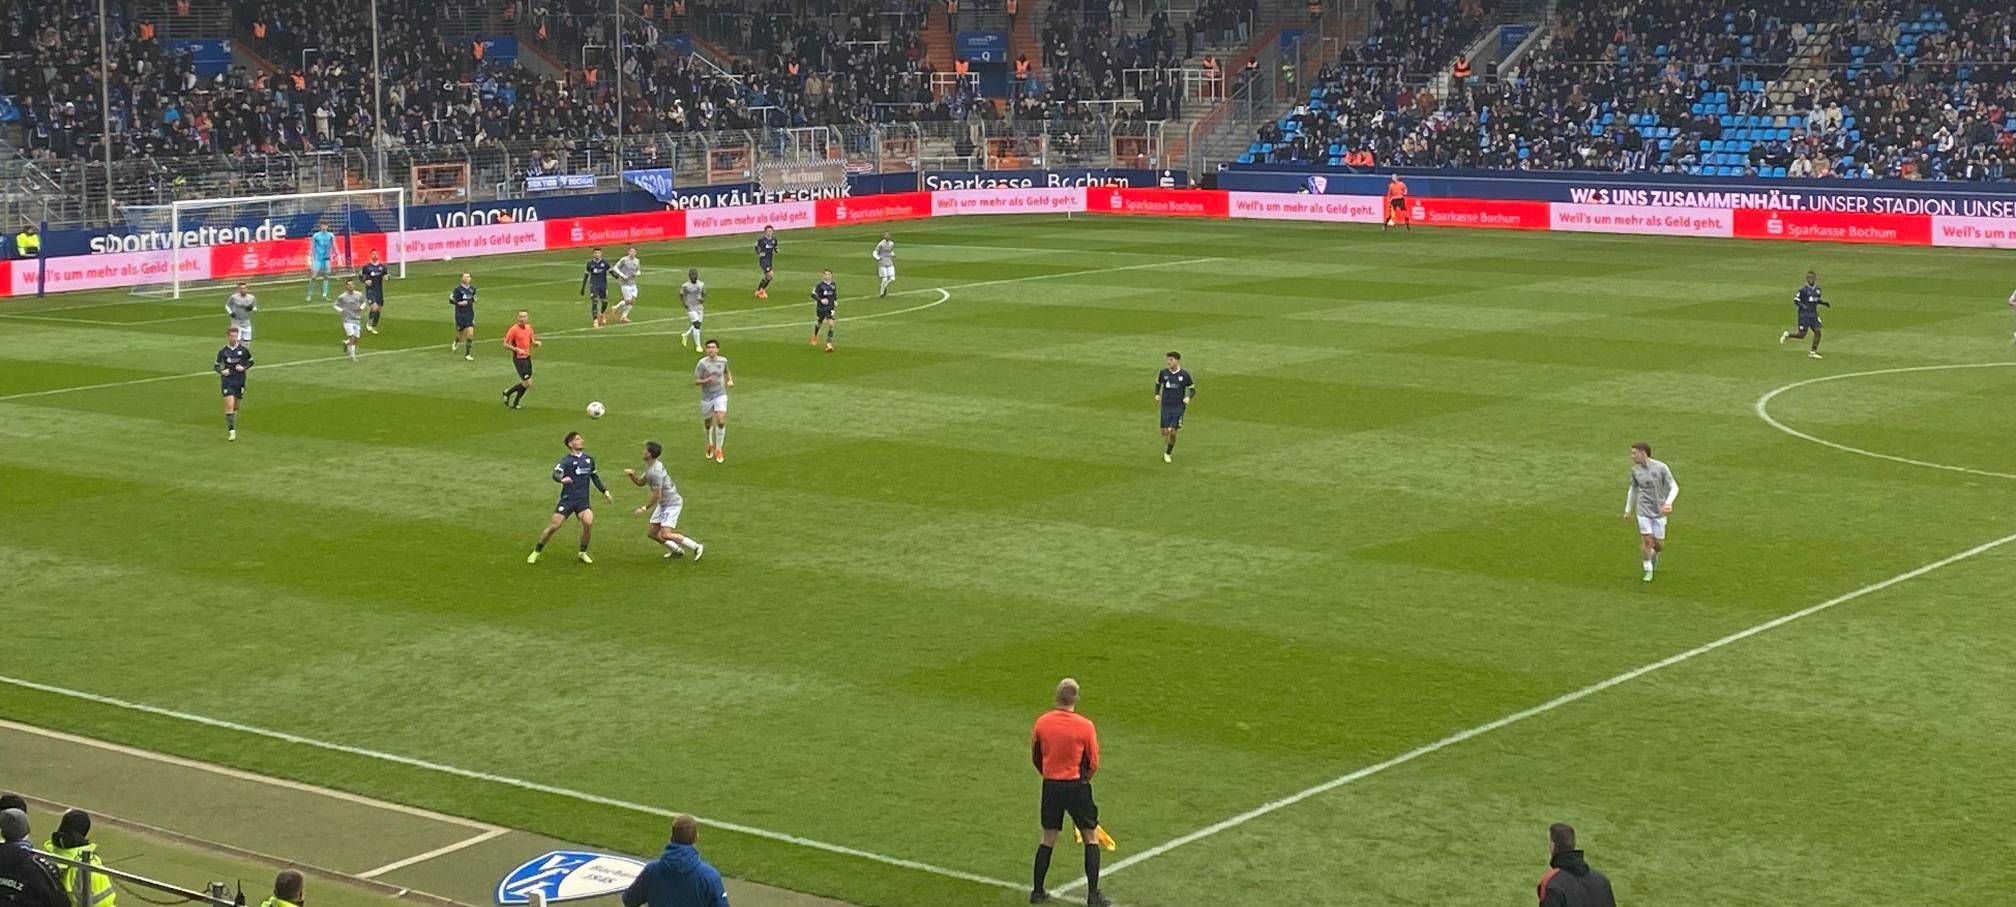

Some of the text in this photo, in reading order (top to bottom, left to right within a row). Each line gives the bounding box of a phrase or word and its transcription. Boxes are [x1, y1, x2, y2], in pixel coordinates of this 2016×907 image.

[1236, 200, 1375, 217] Weil's um mehr als Geld geht.
[1612, 189, 1648, 206] UNS
[1650, 189, 1806, 211] ZUSAMMENHÄLT.
[1809, 195, 1868, 213] UNSER
[1963, 200, 2016, 218] UNSE
[1559, 212, 1723, 231] Weil's um mehr als Geld geht.
[90, 218, 287, 255] sportwetten.de
[1787, 223, 1846, 238] Sparkasse
[1850, 225, 1897, 239] Bochum
[1942, 225, 1981, 238] Weil's
[1985, 229, 2005, 239] um
